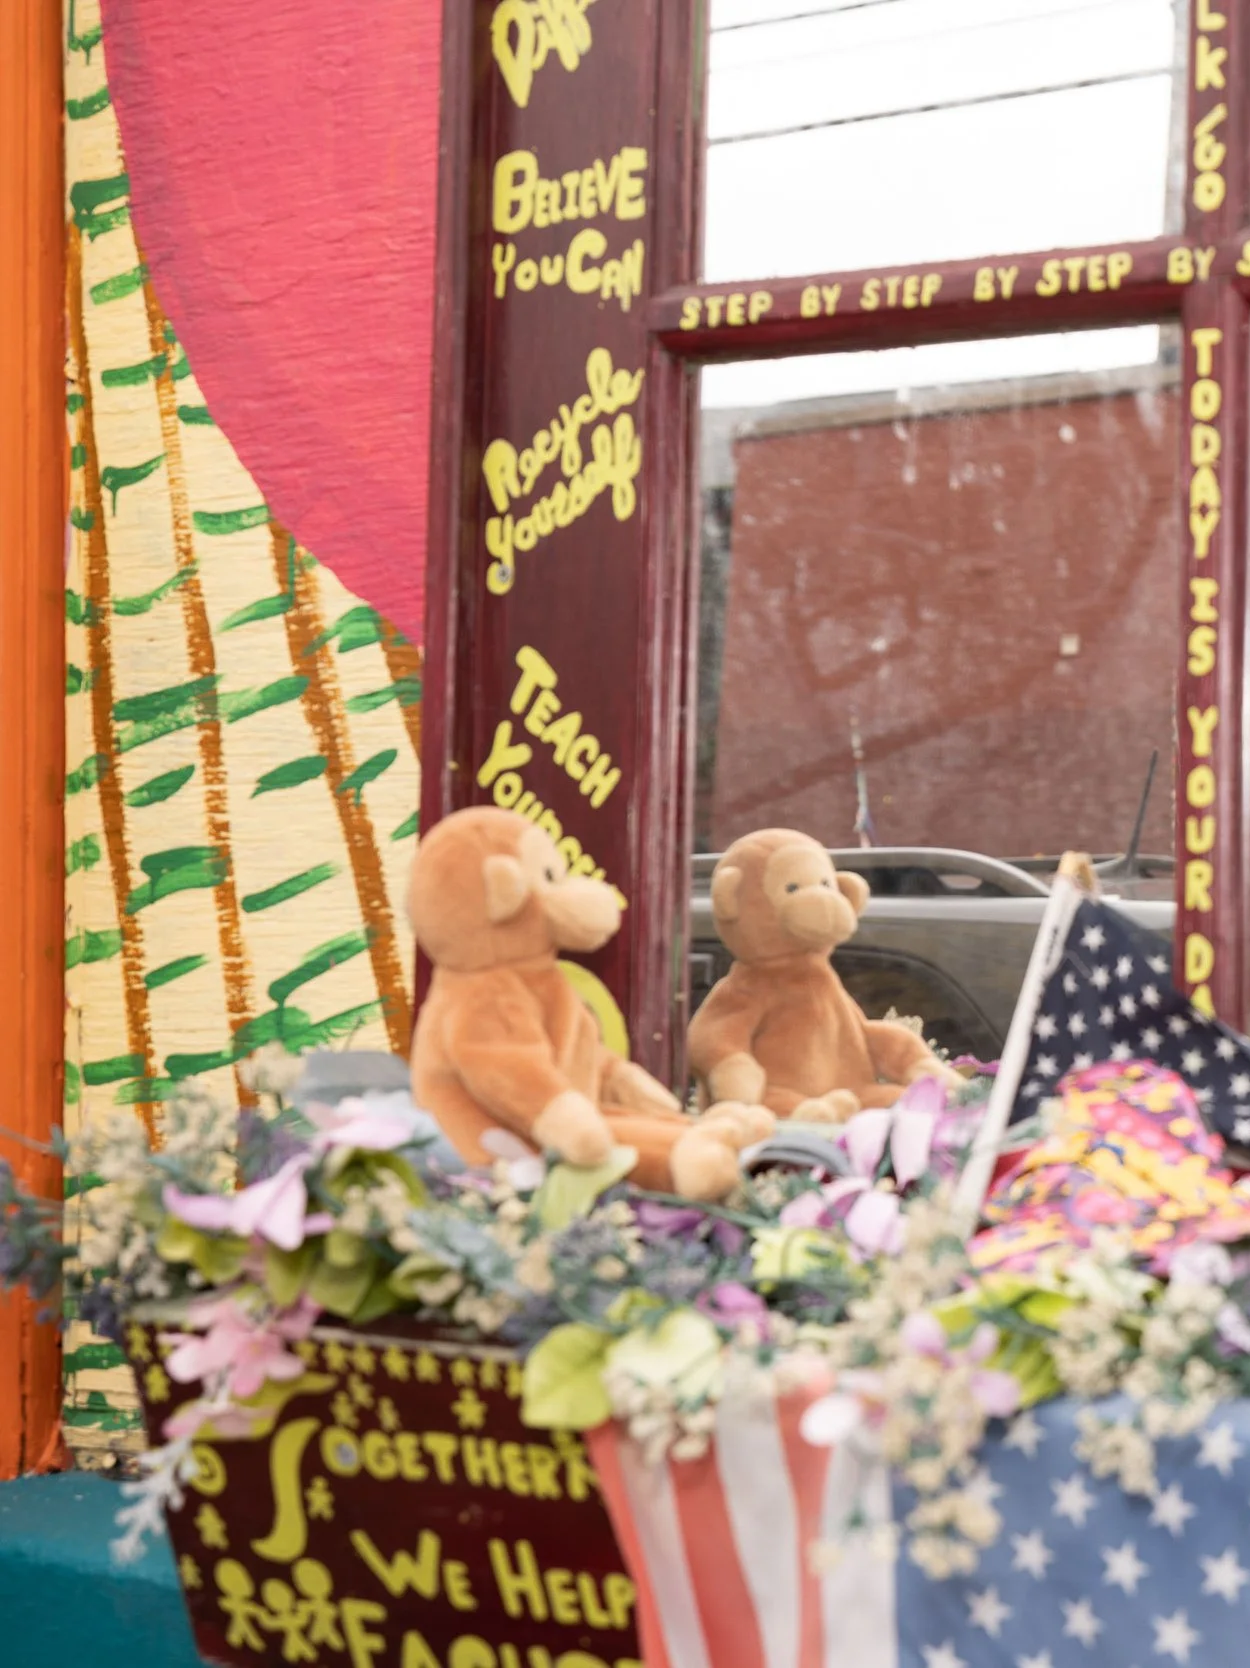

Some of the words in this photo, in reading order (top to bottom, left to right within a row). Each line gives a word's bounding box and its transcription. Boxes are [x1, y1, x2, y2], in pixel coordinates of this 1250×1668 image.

[679, 289, 773, 331] STEP
[799, 284, 841, 319] BY
[859, 273, 943, 311] STEP
[973, 266, 1019, 301] BY
[1035, 252, 1133, 297] STEP
[1167, 246, 1216, 285] BY
[1189, 327, 1223, 559] TODAY
[1187, 577, 1219, 677] IS
[510, 644, 622, 809] TEACH
[1184, 705, 1219, 912] YOUR
[487, 1537, 637, 1630] HELP
